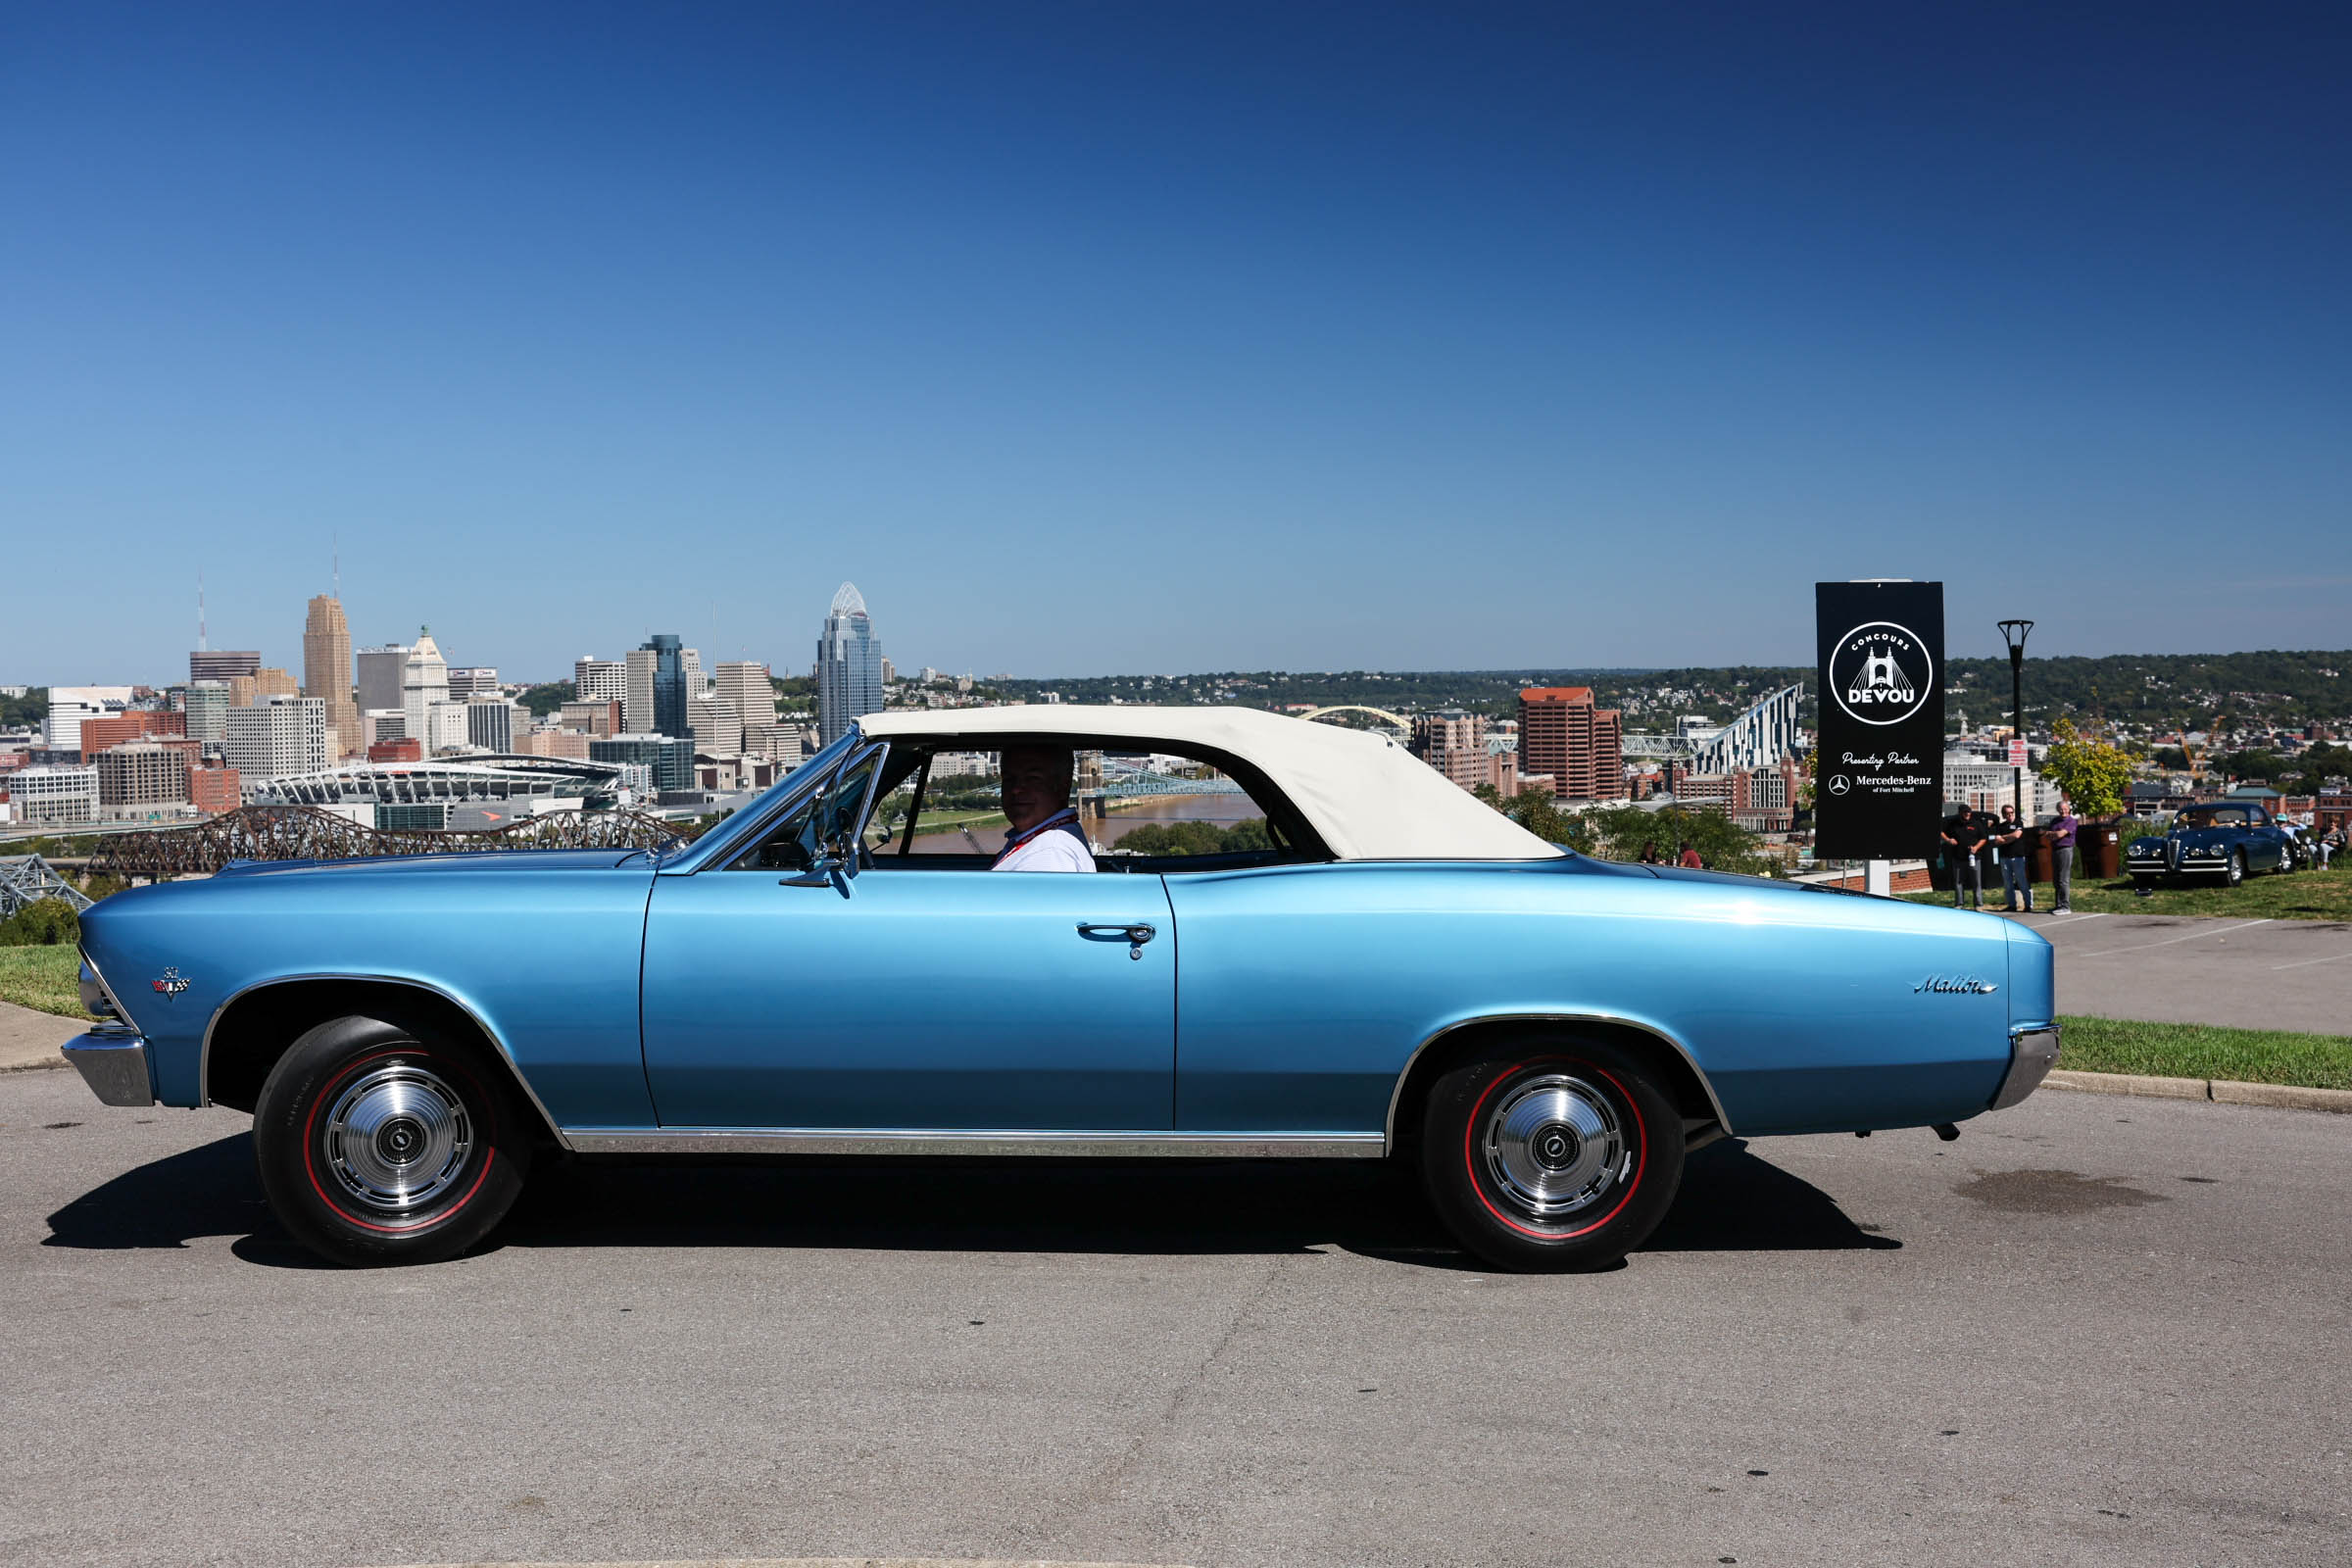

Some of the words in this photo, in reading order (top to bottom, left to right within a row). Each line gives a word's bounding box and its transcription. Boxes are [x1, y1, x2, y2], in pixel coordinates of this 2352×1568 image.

[1851, 633, 1910, 651] CONCOURS
[1848, 689, 1915, 704] DEVOU
[1842, 752, 1885, 771] Presenting
[1887, 752, 1920, 764] Partner
[1856, 775, 1932, 785] Mercedes-Benz
[1912, 974, 1999, 996] Malibu
